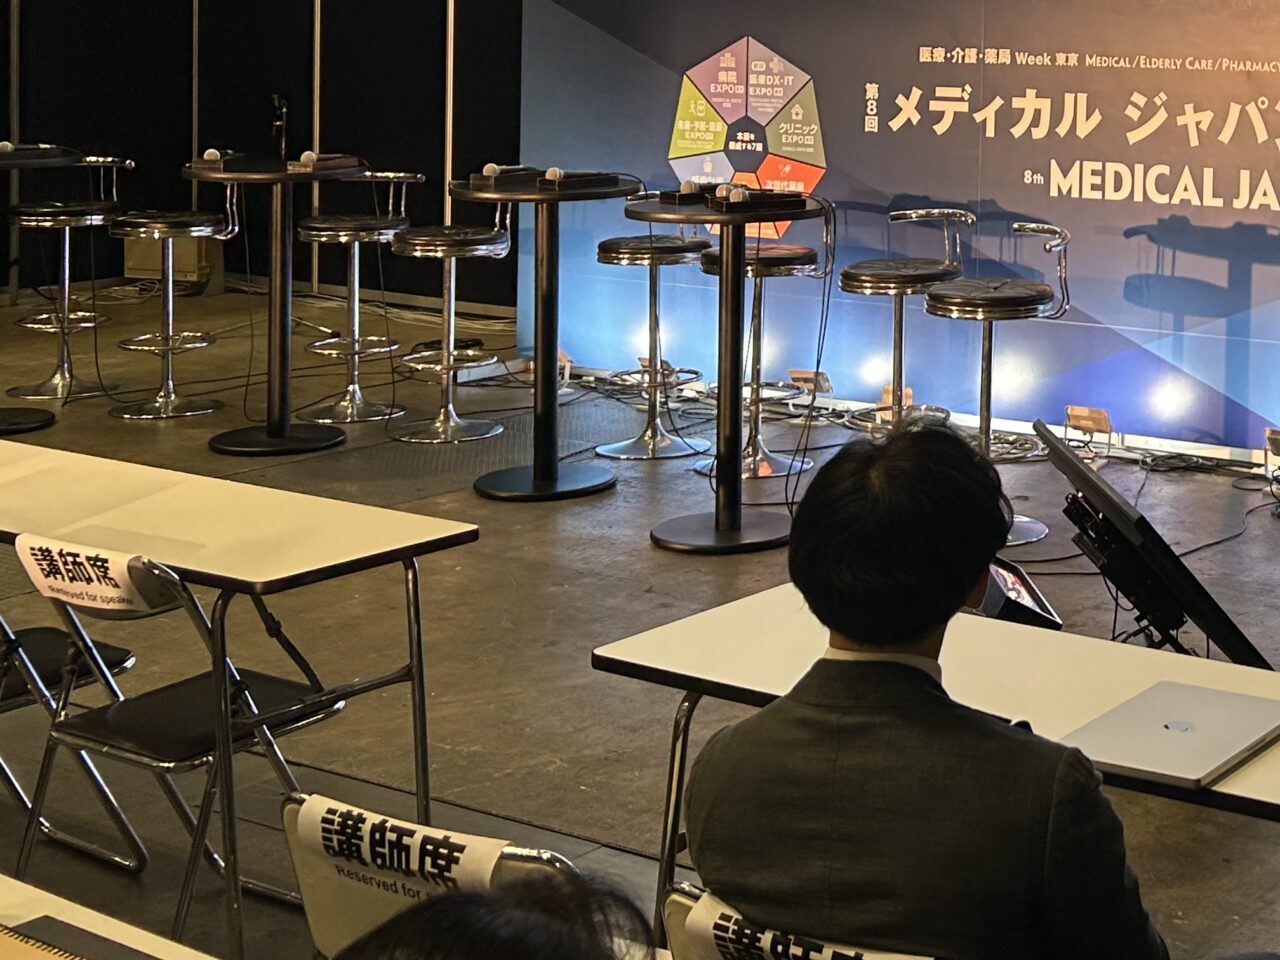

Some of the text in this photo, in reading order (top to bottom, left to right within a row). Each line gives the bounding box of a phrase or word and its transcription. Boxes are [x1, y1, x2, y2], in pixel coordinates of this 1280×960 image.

[919, 46, 1079, 67] 医療・介護・薬局 Week 東京
[710, 84, 735, 93] EXPO
[749, 87, 772, 96] EXPO
[887, 83, 1102, 139] メディカル
[779, 123, 818, 135] クリニック
[781, 134, 804, 144] EXPO
[1023, 168, 1044, 186] 8th
[1049, 158, 1227, 207] MEDICAL
[29, 546, 121, 589] 講師席
[320, 807, 467, 890] 講師席
[335, 864, 398, 895] Reserved
[401, 883, 421, 900] for
